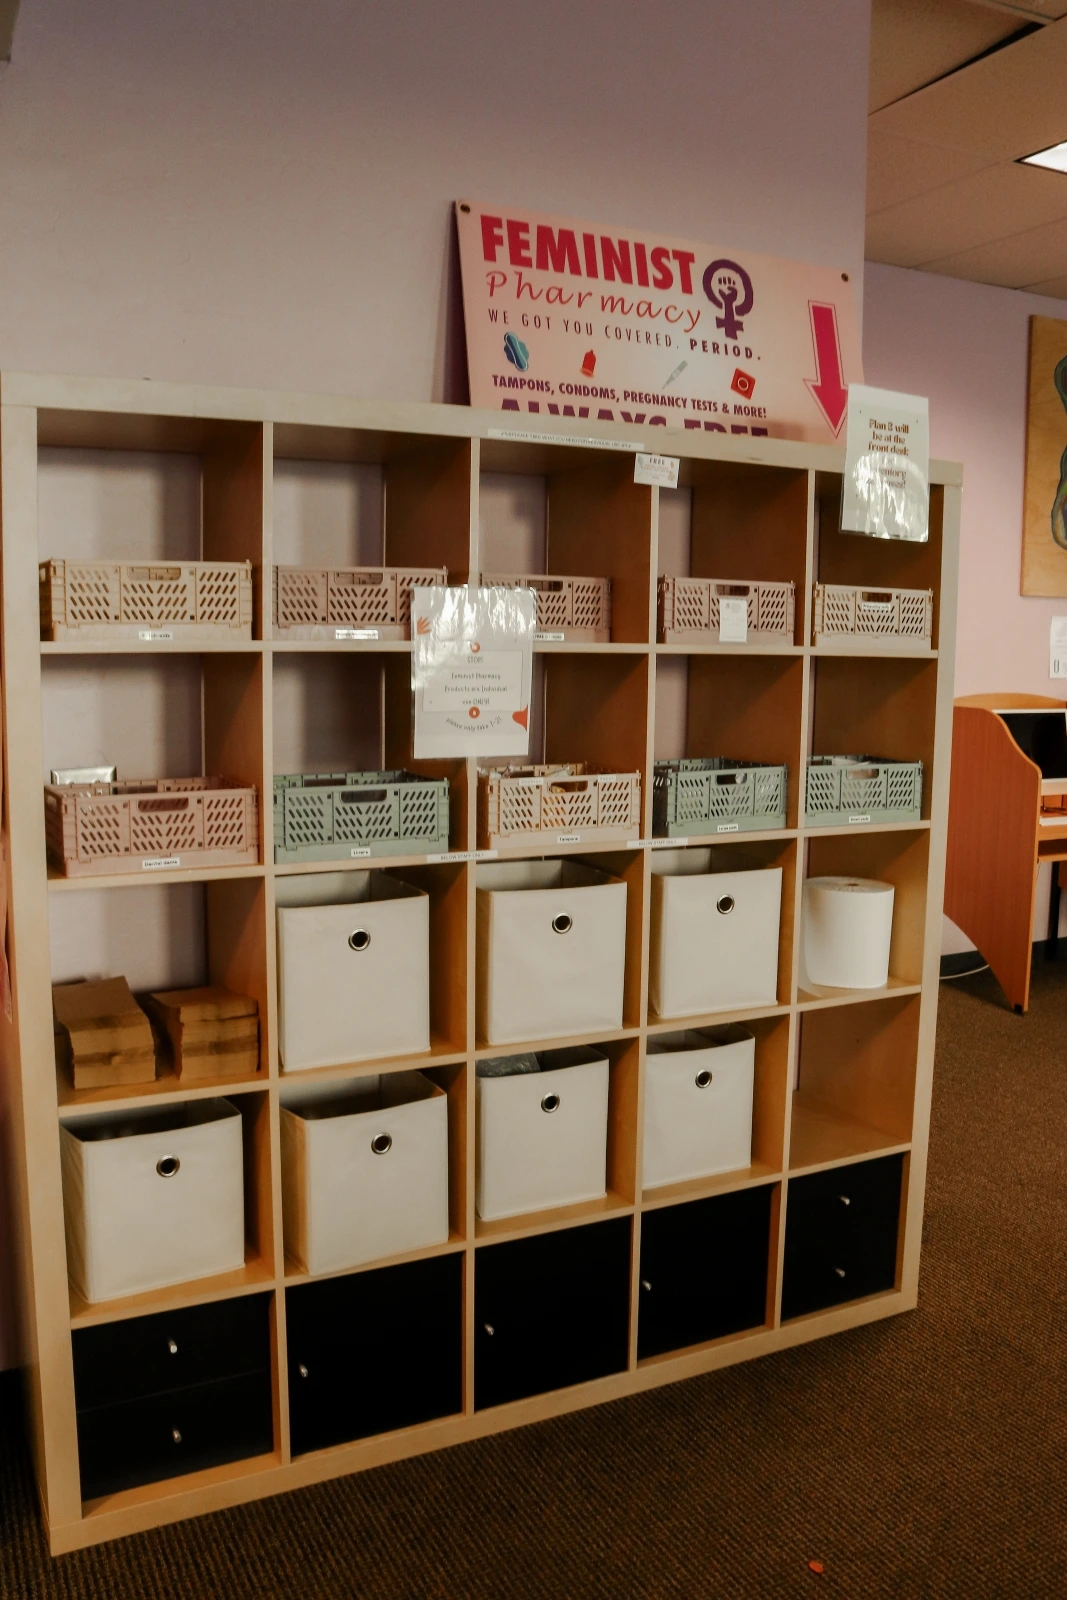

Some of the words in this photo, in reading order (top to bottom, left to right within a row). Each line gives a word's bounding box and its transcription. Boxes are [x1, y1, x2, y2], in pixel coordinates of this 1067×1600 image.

[480, 214, 695, 295] FEMINIST
[485, 270, 701, 333] Pharmacy
[488, 308, 510, 324] WE
[521, 313, 552, 330] GOT
[562, 318, 594, 336] YOU
[604, 324, 679, 348] COVERED.
[689, 338, 762, 360] PERIOD.
[492, 374, 556, 395] TAMPONS,
[558, 382, 620, 403] CONDOMS,
[623, 390, 688, 409] PREGNANCY
[691, 399, 720, 413] TESTS
[721, 402, 730, 414] &
[732, 403, 767, 419] MORE!
[869, 419, 886, 430] Plan
[888, 422, 893, 431] B
[895, 424, 909, 434] will
[872, 431, 882, 441] be
[884, 434, 892, 442] at
[894, 435, 906, 444] the
[868, 441, 888, 452] front
[452, 672, 474, 680] Feminist
[476, 672, 501, 680] Pharmacy
